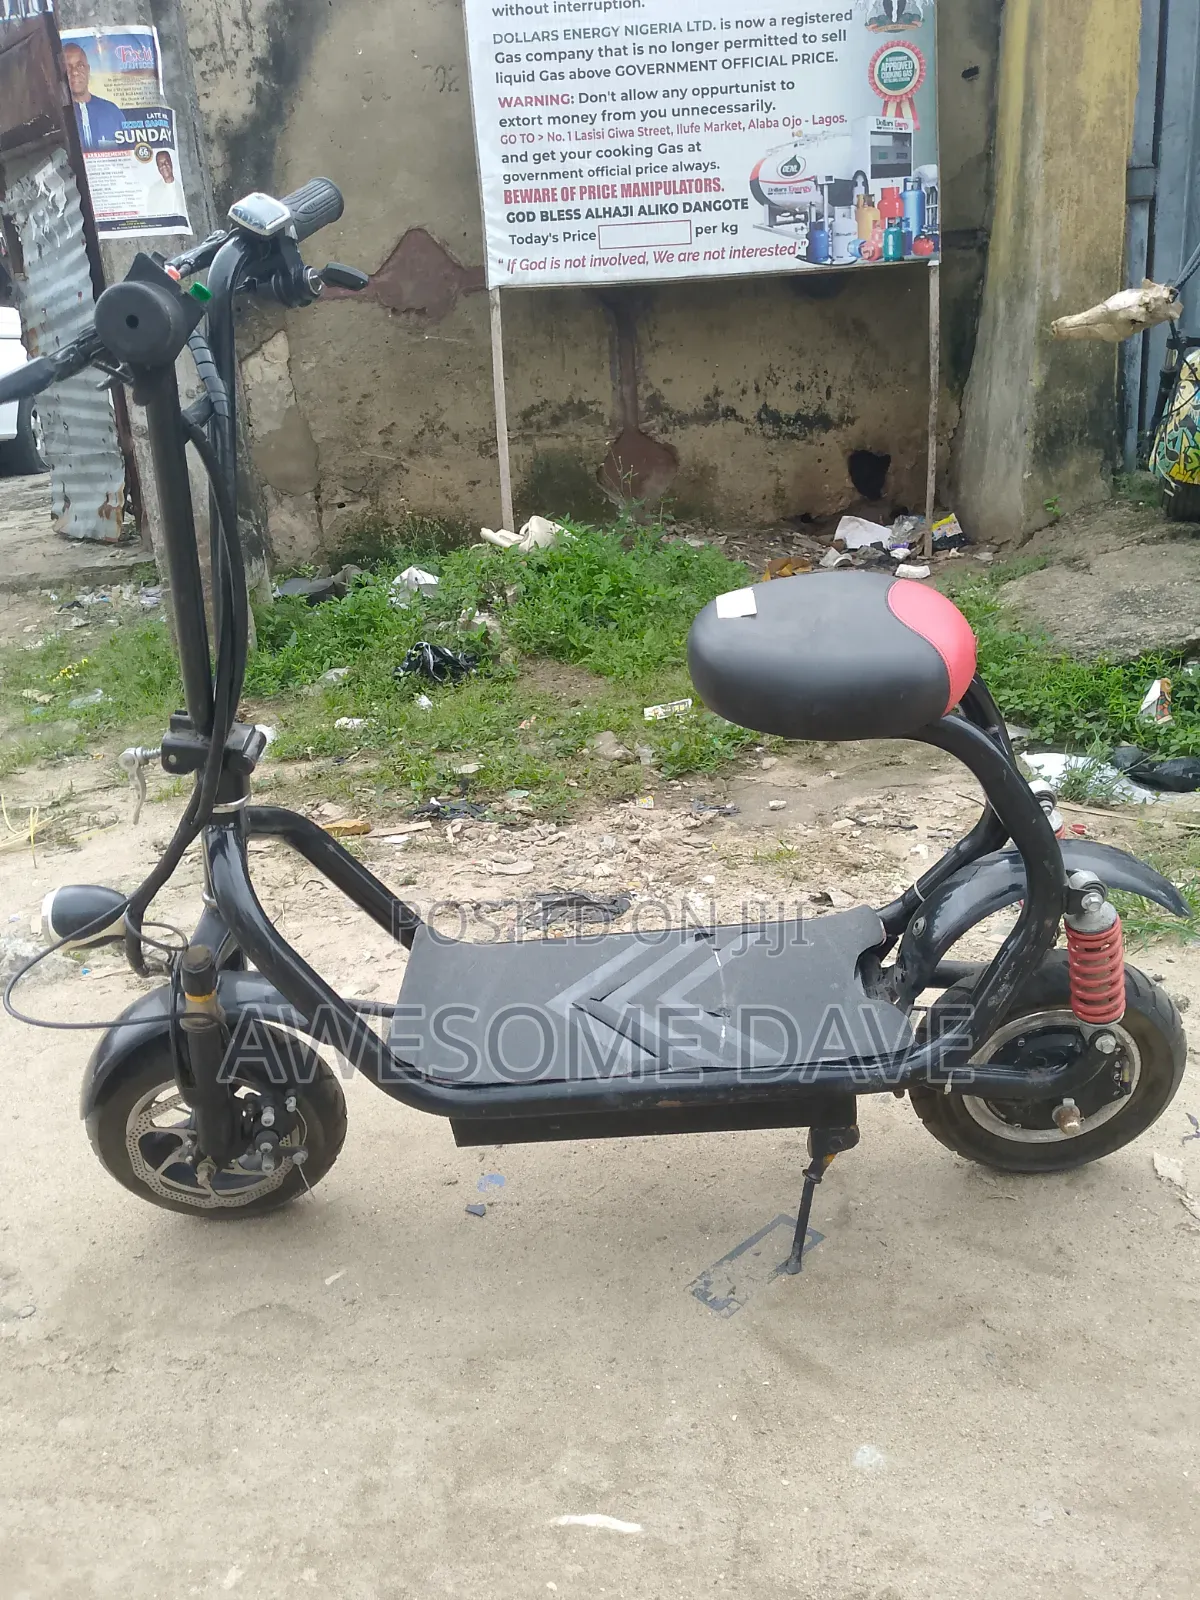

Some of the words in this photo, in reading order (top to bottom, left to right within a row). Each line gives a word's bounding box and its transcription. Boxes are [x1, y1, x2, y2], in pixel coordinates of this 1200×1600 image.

[492, 3, 549, 17] without
[553, 0, 645, 14] interruption.
[493, 29, 559, 45] DOLLARS
[563, 26, 620, 40] ENERGY
[624, 22, 683, 36] NIGERIA
[686, 19, 717, 32] LTD.
[720, 17, 732, 30] is
[735, 17, 765, 29] now
[769, 16, 777, 27] a
[781, 9, 853, 28] registered
[494, 51, 522, 64] Gas
[525, 48, 594, 64] company
[598, 45, 629, 58] that
[633, 43, 645, 55] is
[648, 42, 668, 55] no
[671, 39, 720, 55] longer
[724, 32, 798, 52] permitted
[802, 32, 818, 45] to
[821, 29, 847, 43] sell
[495, 70, 535, 86] liquid
[539, 69, 566, 82] Gas
[568, 66, 612, 80] above
[615, 59, 718, 77] GOVERNMENT
[721, 55, 788, 70] OFFICIAL
[791, 51, 839, 66] PRICE.
[881, 60, 913, 72] APPROVED
[498, 93, 575, 109] WARNING:
[578, 90, 617, 105] Don't
[620, 88, 659, 102] allow
[662, 86, 688, 101] any
[691, 80, 777, 99] oppurtunist
[781, 79, 796, 91] to
[499, 114, 544, 129] extort
[547, 111, 598, 127] money
[601, 109, 637, 122] from
[640, 107, 668, 122] you
[671, 99, 777, 118] unnecessarily.
[114, 128, 172, 144] SUNDAY
[500, 134, 520, 146] GO
[521, 133, 536, 144] TO
[547, 131, 566, 143] No.
[574, 128, 605, 142] Lasisi
[607, 127, 635, 140] Giwa
[637, 124, 674, 139] Street,
[704, 119, 747, 134] Market,
[747, 117, 780, 131] Alaba
[782, 115, 803, 130] Ojo
[812, 113, 848, 128] Lagos.
[501, 150, 529, 164] and
[532, 150, 557, 165] get
[560, 148, 593, 163] your
[595, 143, 654, 160] cooking
[657, 142, 684, 155] Gas
[687, 141, 703, 153] at
[502, 166, 584, 185] government
[587, 164, 632, 178] official
[635, 162, 669, 177] price
[672, 159, 721, 175] always.
[503, 188, 558, 205] BEWARE
[560, 186, 577, 202] OF
[579, 183, 618, 201] PRICE
[620, 176, 725, 198] MANIPULATORS.
[506, 210, 536, 224] GOD
[540, 208, 582, 222] BLESS
[585, 205, 634, 220] ALHAJI
[637, 202, 679, 217] ALIKO
[682, 198, 749, 215] DANGOTE
[508, 233, 560, 246] Today's
[563, 230, 597, 243] Price
[695, 224, 718, 238] per
[721, 222, 739, 235] kg
[520, 257, 547, 271] God
[550, 256, 561, 270] is
[564, 254, 587, 269] not
[590, 251, 650, 268] involved,
[653, 249, 675, 265] We
[677, 250, 700, 263] are
[703, 246, 726, 261] not
